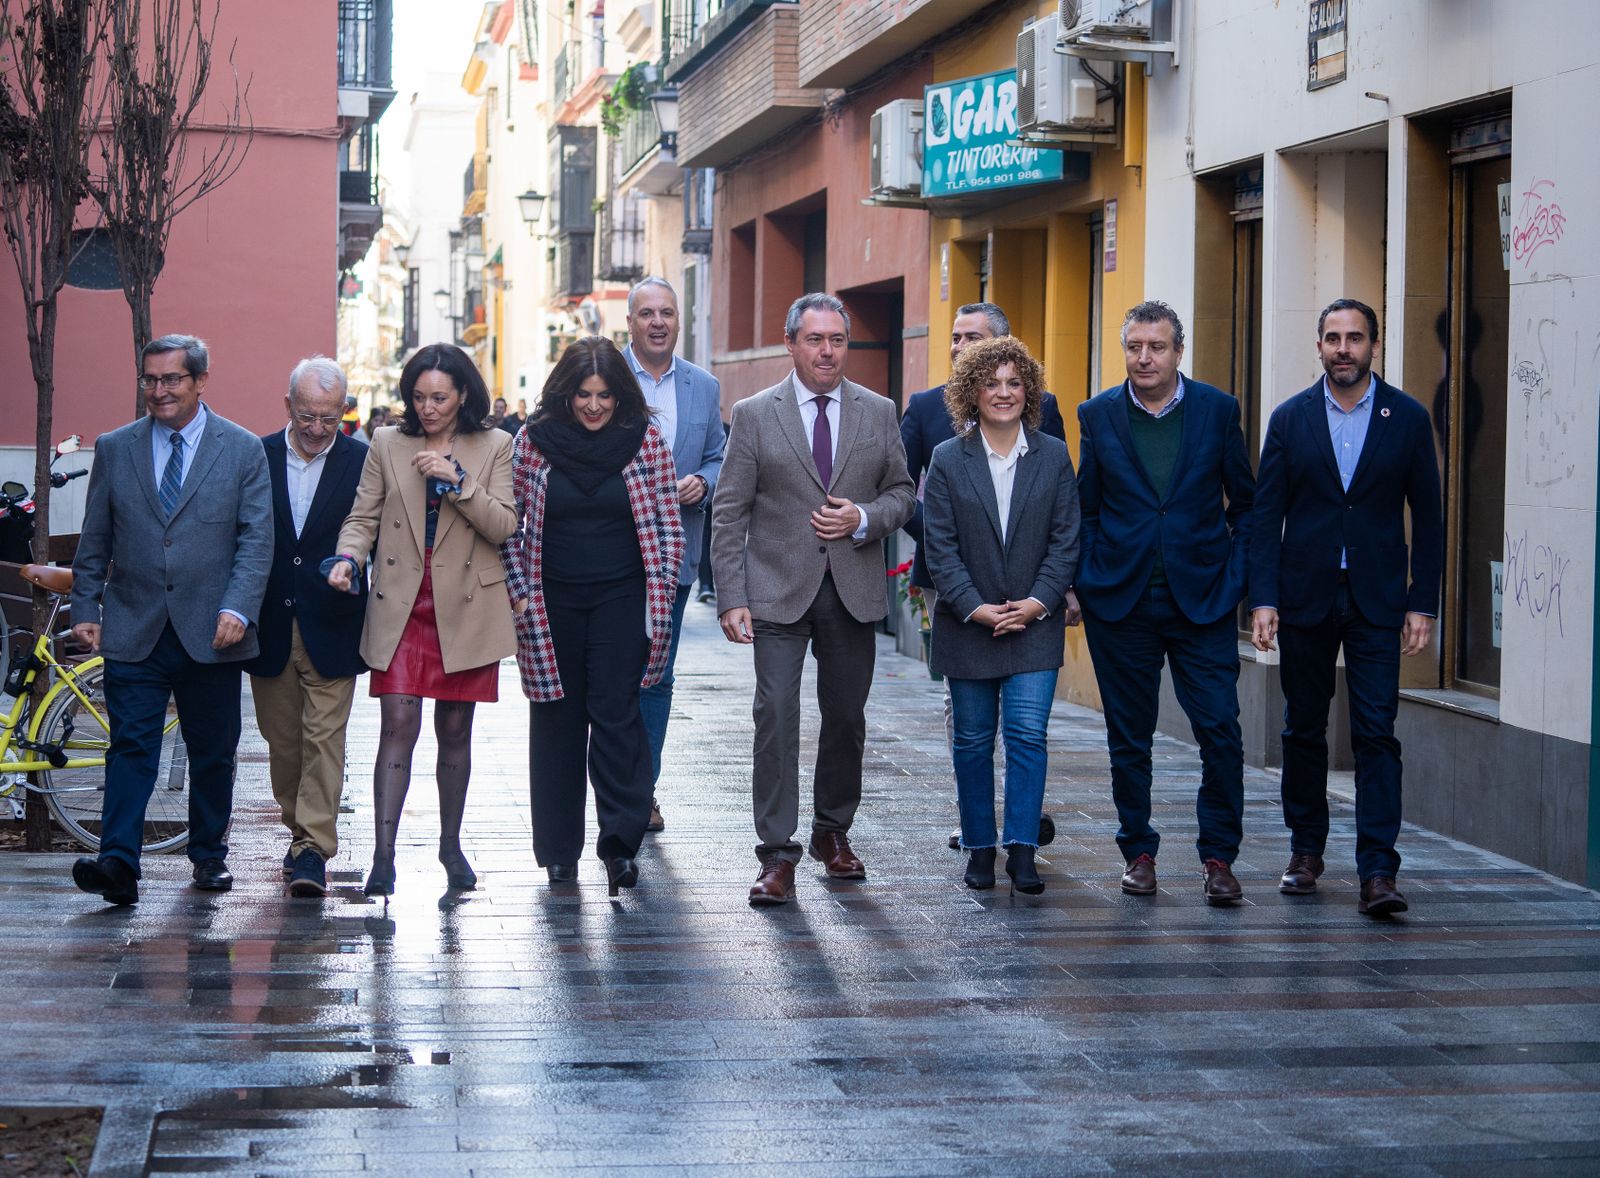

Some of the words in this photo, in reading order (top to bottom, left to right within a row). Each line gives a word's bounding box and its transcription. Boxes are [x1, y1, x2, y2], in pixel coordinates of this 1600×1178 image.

[953, 79, 1018, 139] GAR
[971, 176, 991, 187] 954
[994, 173, 1014, 183] 901
